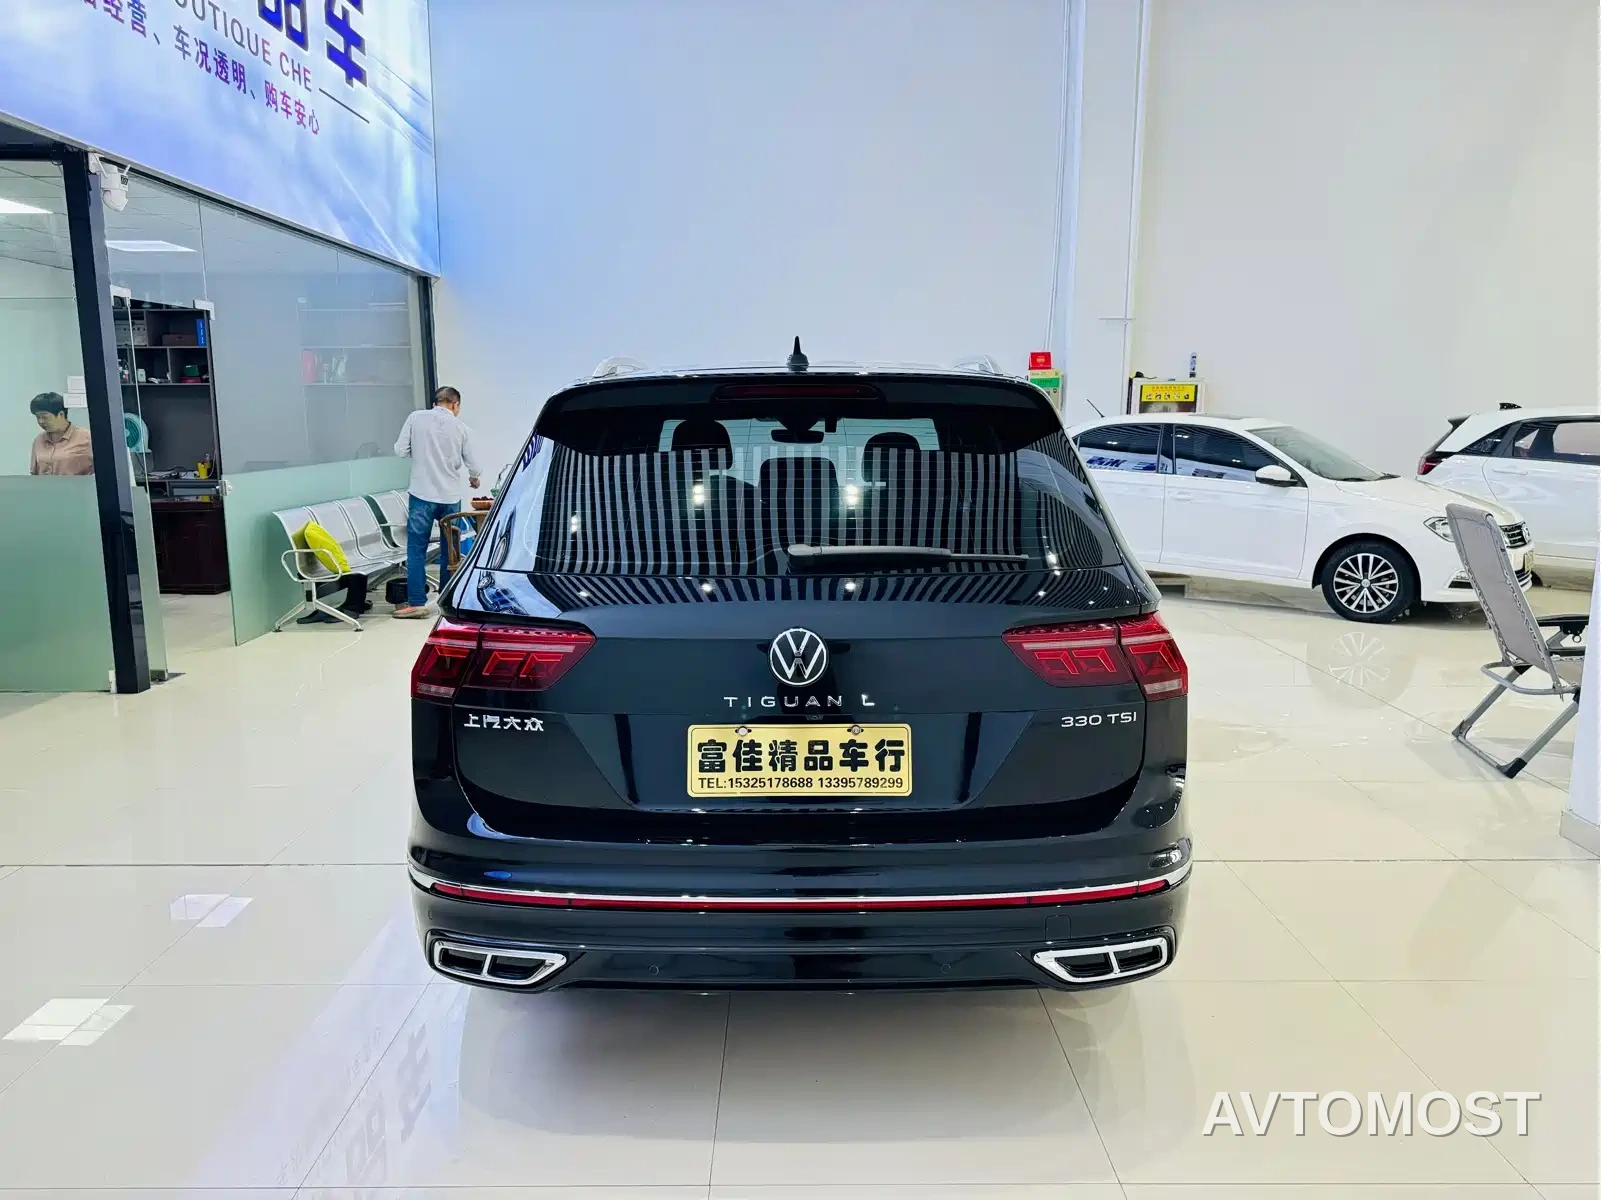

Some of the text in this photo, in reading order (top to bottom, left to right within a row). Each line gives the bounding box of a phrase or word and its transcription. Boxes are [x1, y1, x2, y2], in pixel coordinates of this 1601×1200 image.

[279, 51, 312, 93] CHE
[723, 694, 876, 708] TIGUAN L
[463, 713, 545, 732] 上汽大众
[1061, 711, 1137, 728] 330 TSI
[697, 738, 905, 773] 富佳精品车行
[818, 777, 904, 790] 13395789299
